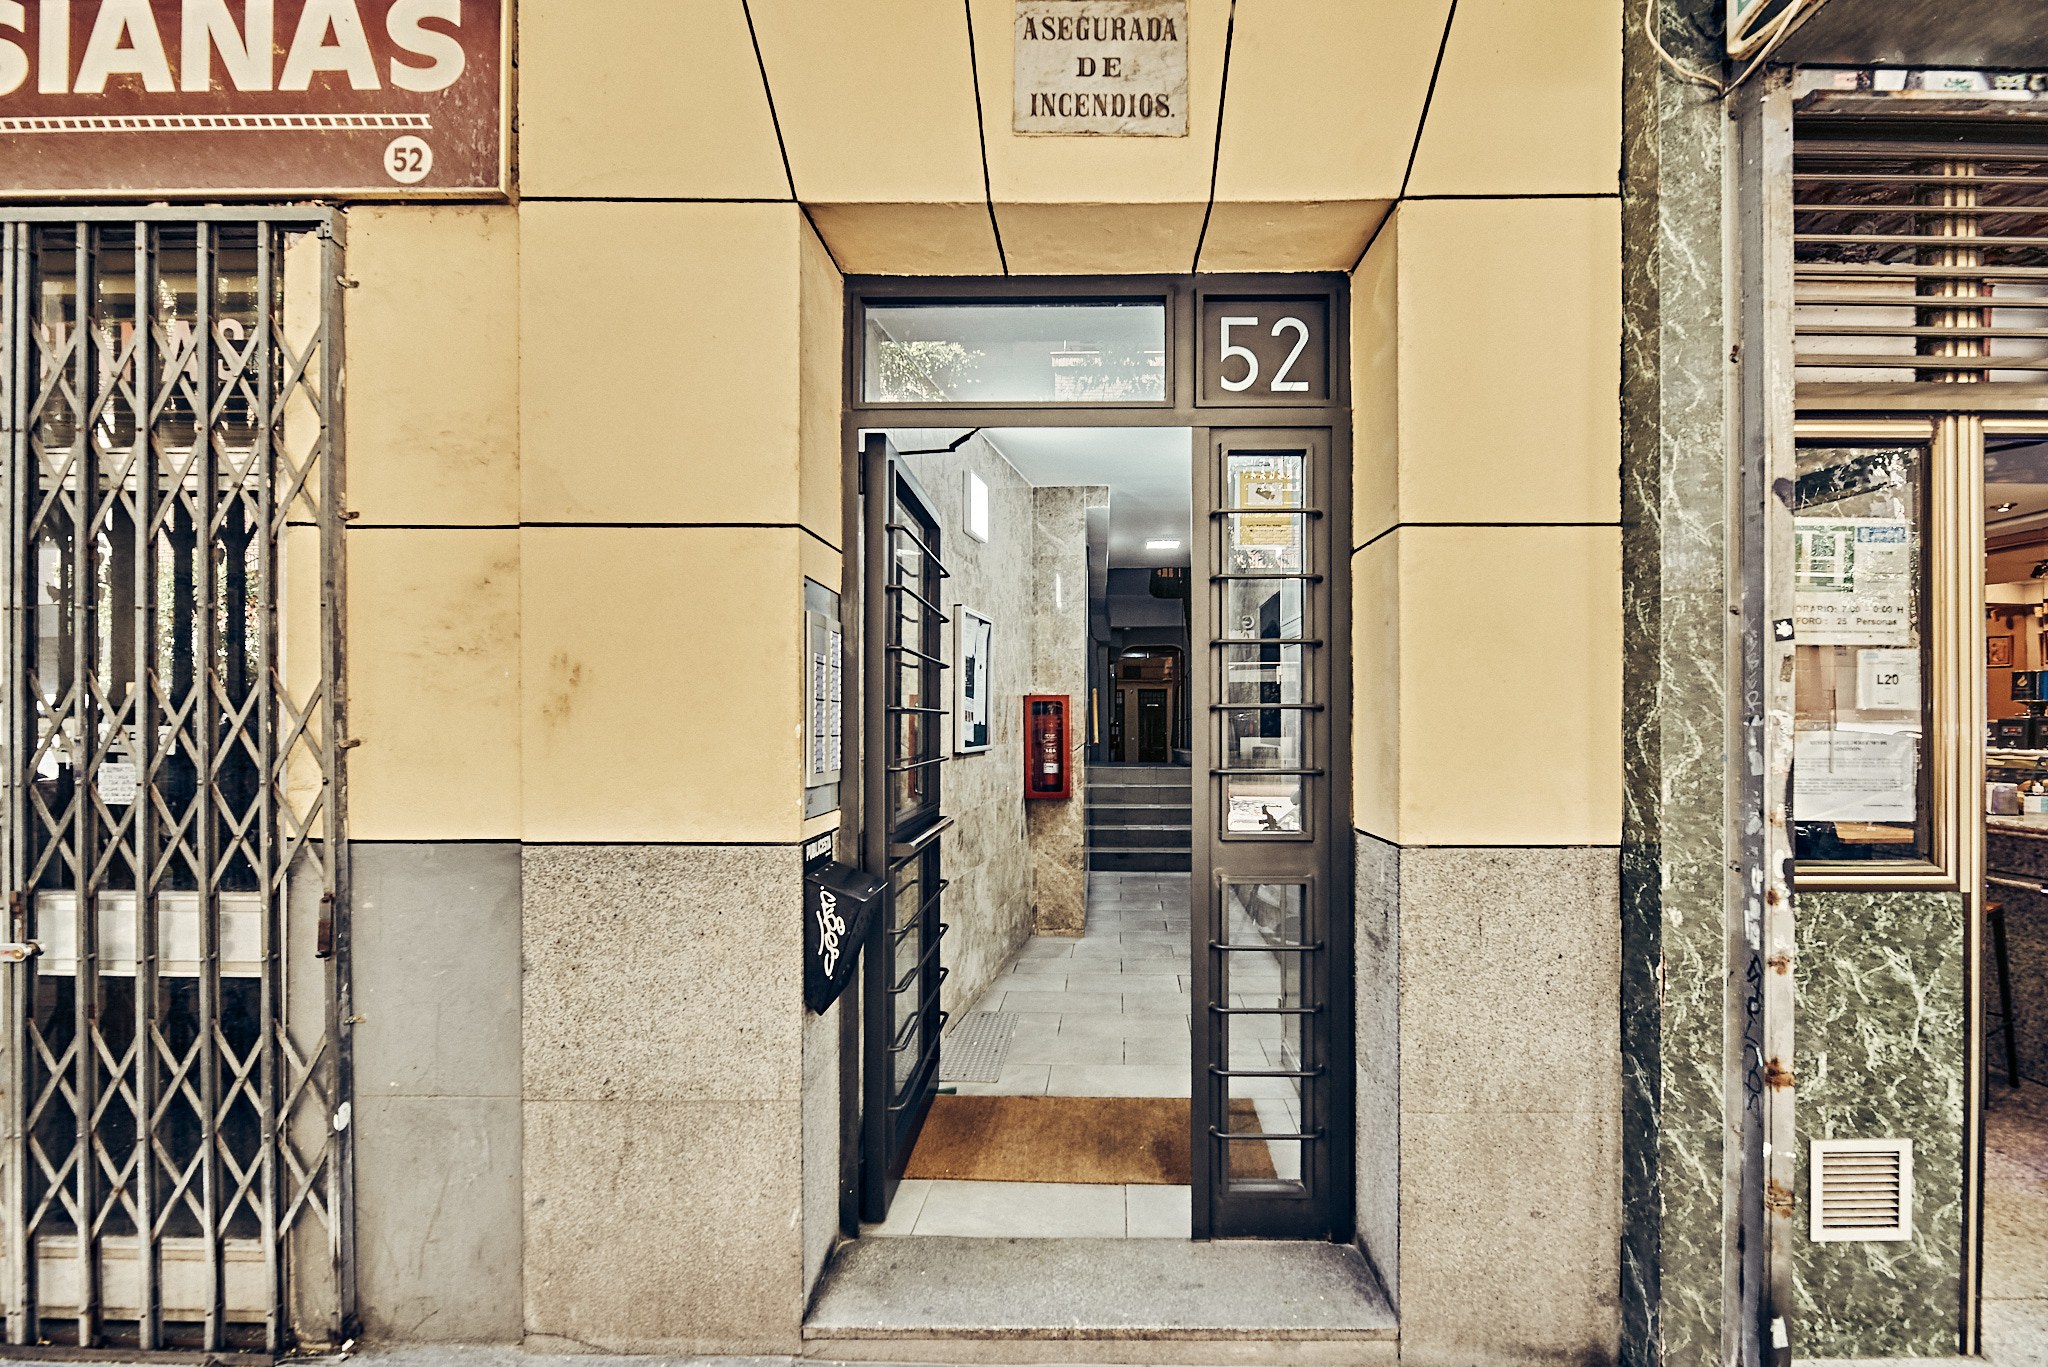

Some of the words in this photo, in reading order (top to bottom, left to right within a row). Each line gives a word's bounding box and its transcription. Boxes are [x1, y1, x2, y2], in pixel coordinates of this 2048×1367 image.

[1022, 16, 1178, 41] ASEGURADA
[1075, 56, 1122, 78] DE
[1030, 92, 1175, 118] INCENDIOS.
[392, 147, 423, 172] 52
[1220, 316, 1310, 392] 52
[1837, 617, 1847, 625] 25
[1856, 617, 1898, 626] Personas
[1876, 673, 1900, 685] L20
